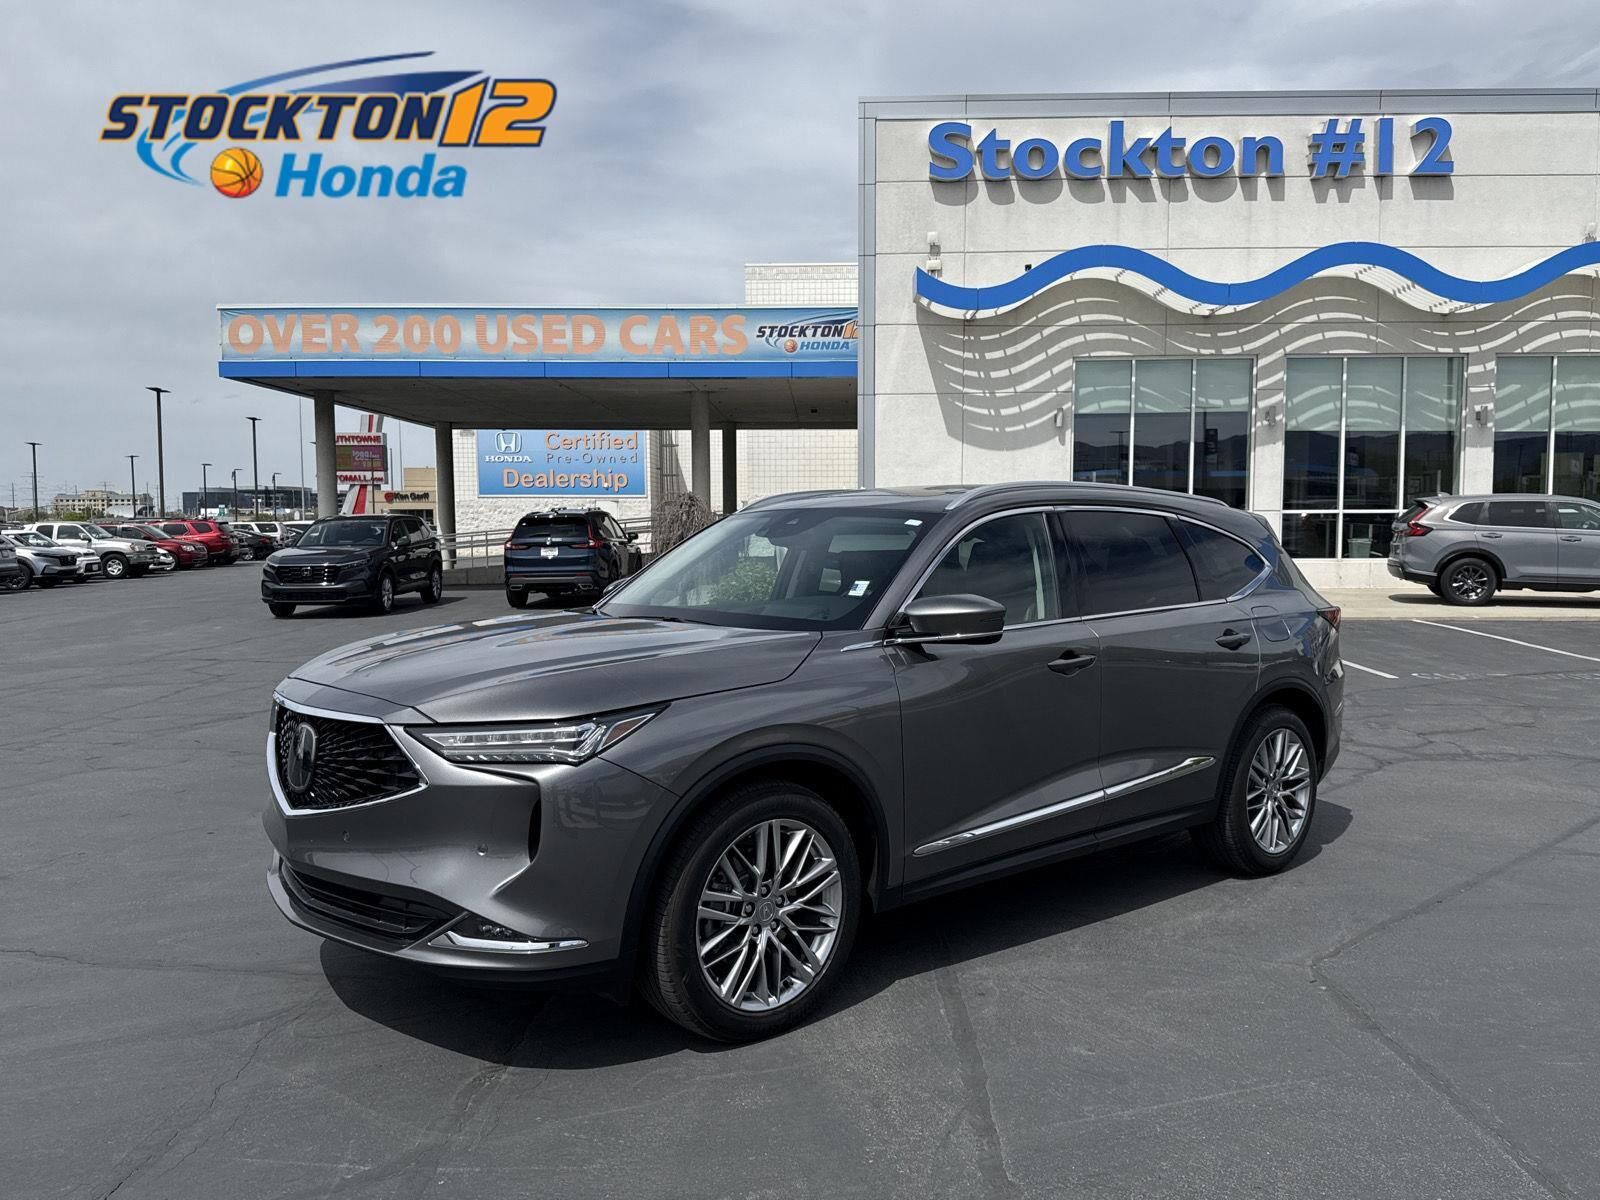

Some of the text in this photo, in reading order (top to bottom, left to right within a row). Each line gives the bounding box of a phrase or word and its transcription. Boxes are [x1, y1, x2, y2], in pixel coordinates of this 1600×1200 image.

[927, 120, 1284, 182] Stockton
[227, 313, 749, 355] OVER 200 USED CARS
[756, 325, 844, 338] STOCKTON
[800, 341, 849, 350] HONDA
[544, 431, 638, 450] Certified
[485, 455, 533, 463] HONDA
[546, 453, 638, 464] Pre-Owned
[503, 468, 628, 493] Dealership
